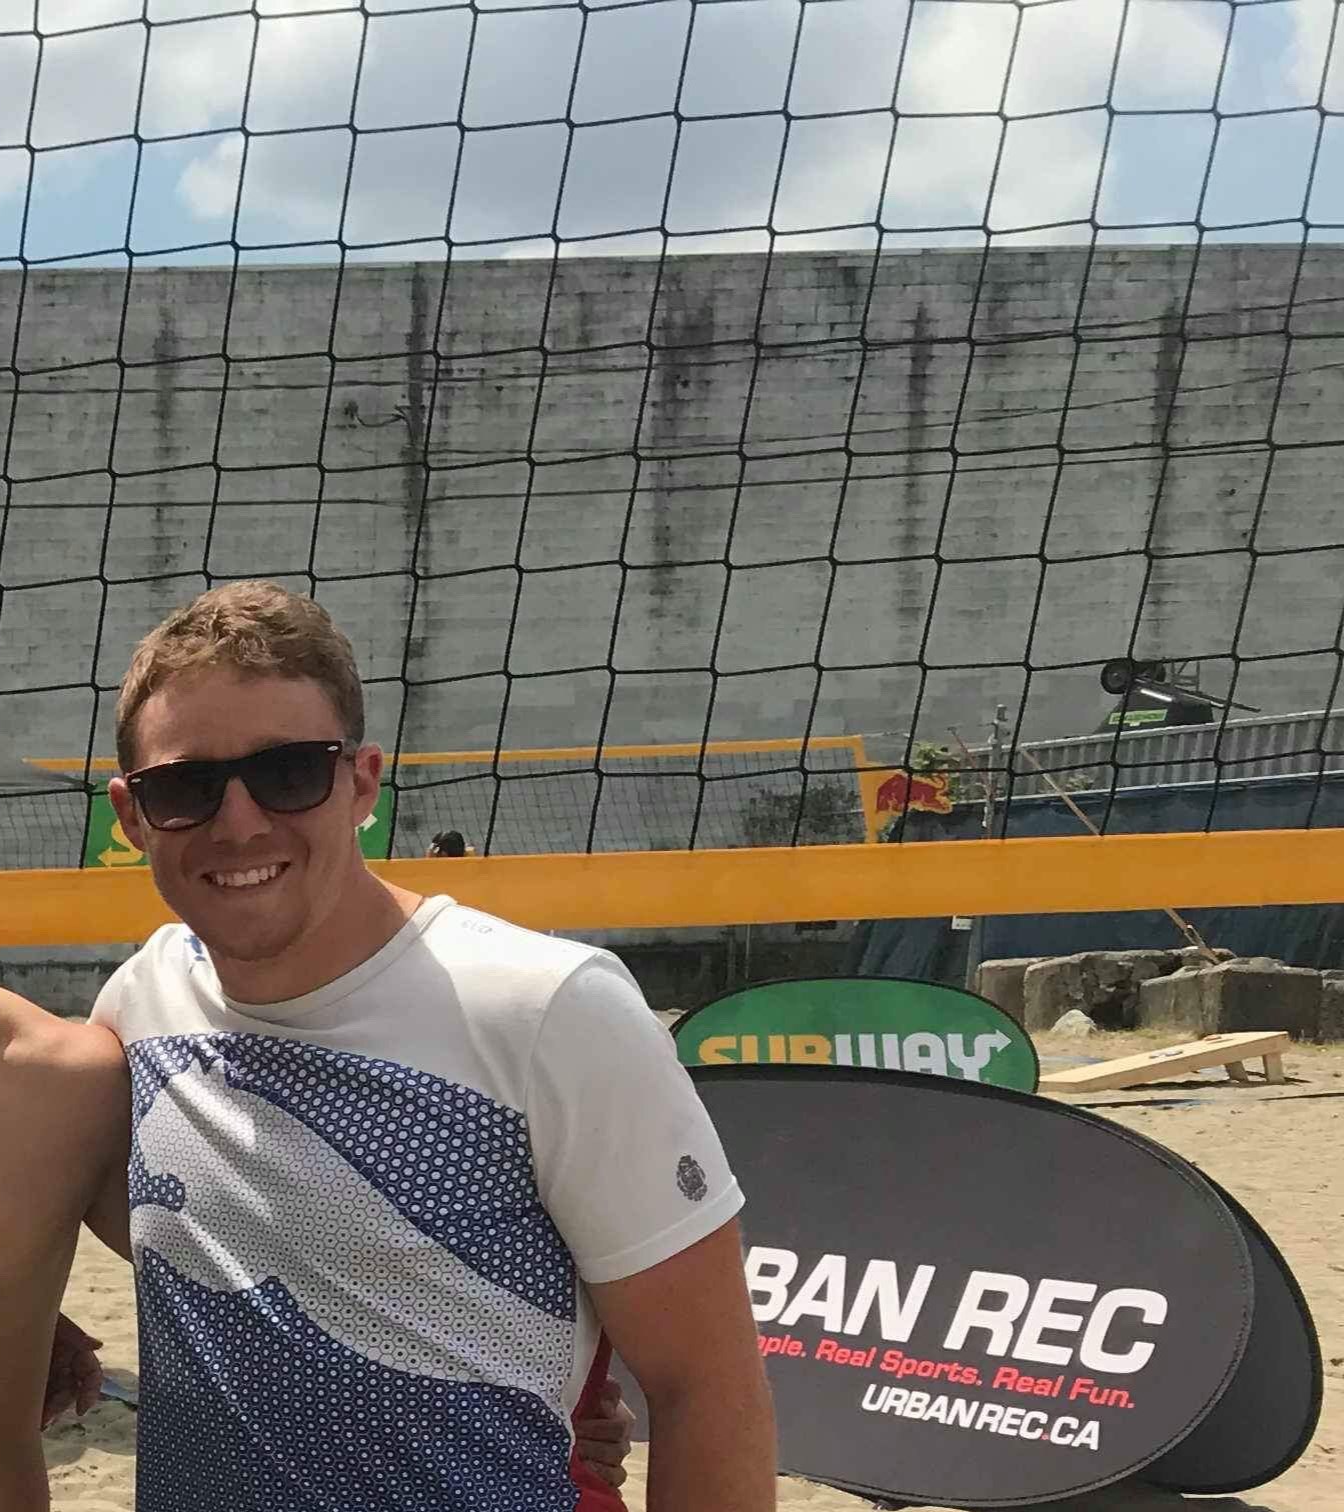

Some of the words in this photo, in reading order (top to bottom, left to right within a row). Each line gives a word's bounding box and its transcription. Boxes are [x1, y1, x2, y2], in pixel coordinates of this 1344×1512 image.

[698, 1030, 1012, 1082] SUBWAY
[743, 1246, 937, 1343] BAN
[943, 1270, 1169, 1375] REC
[757, 1333, 808, 1358] ple.
[814, 1337, 878, 1368] Real
[879, 1349, 984, 1388] Sports.
[991, 1365, 1064, 1400] Real
[1069, 1376, 1136, 1410] Fun.
